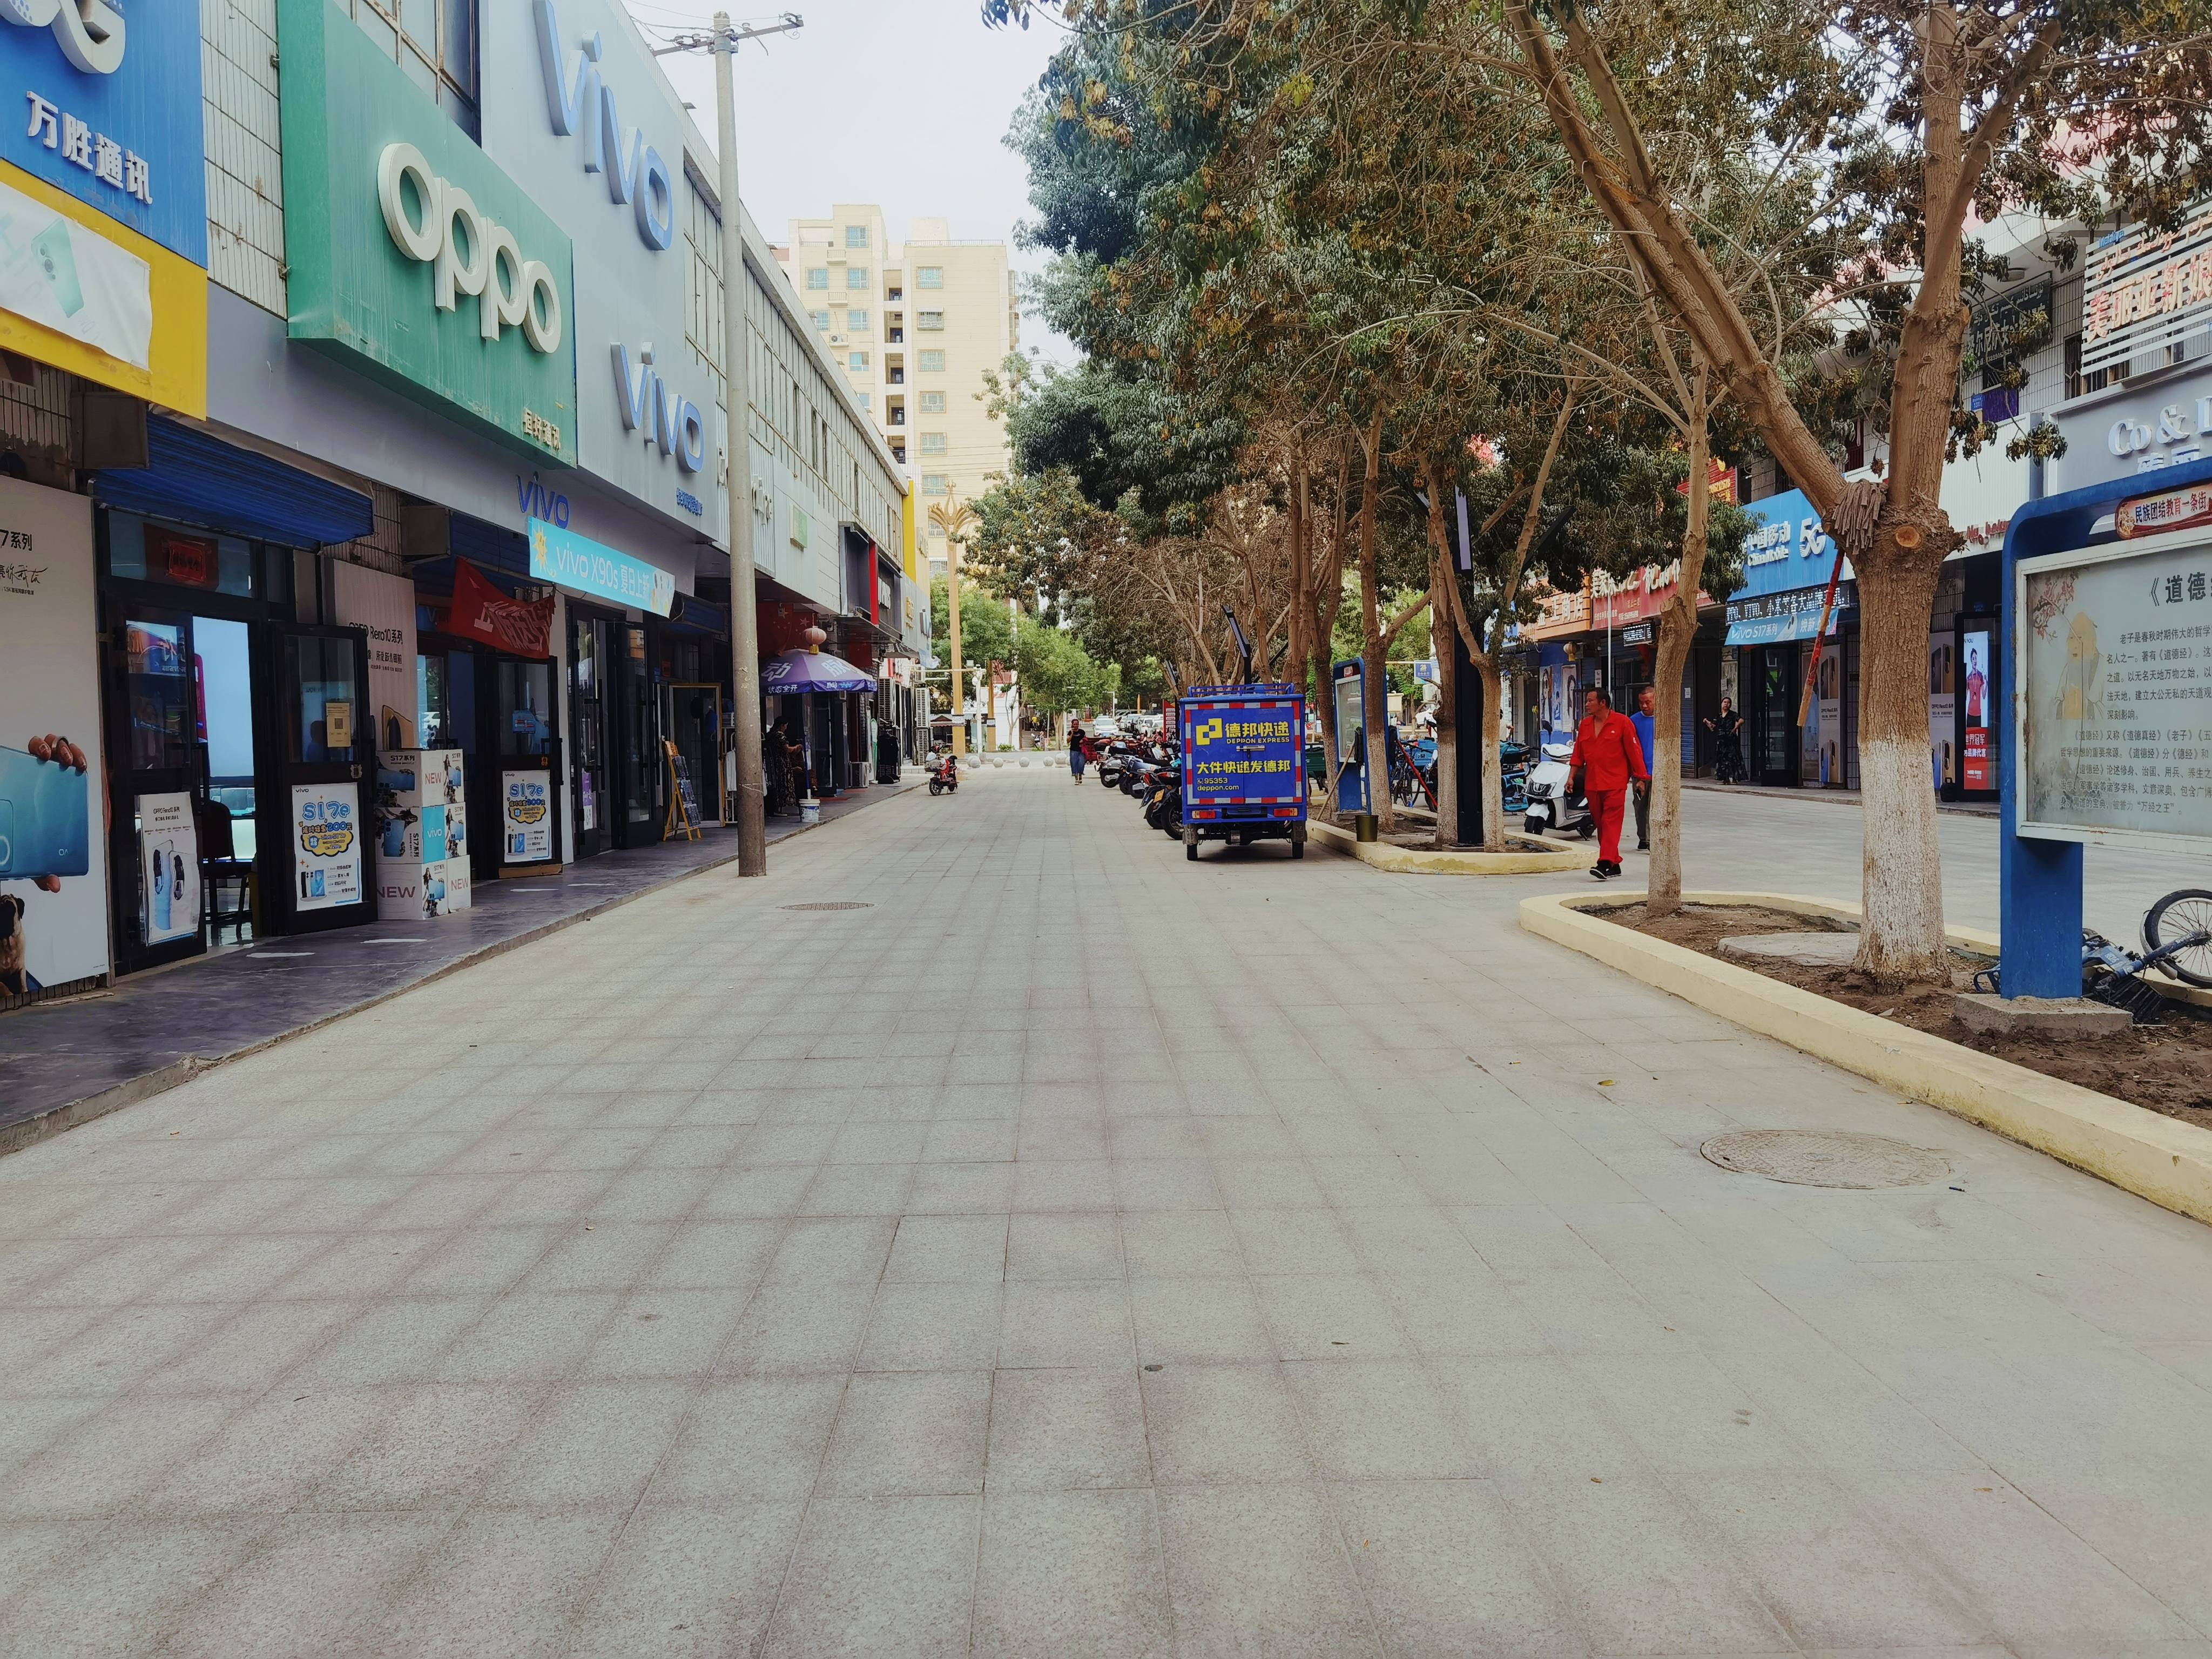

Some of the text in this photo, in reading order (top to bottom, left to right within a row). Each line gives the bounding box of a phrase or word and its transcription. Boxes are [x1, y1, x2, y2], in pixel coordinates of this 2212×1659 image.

[534, 0, 673, 251] vivo
[26, 91, 153, 205] 万胜通讯
[377, 143, 562, 353] oppo
[2087, 252, 2212, 344] 美丽亚新娘
[611, 342, 704, 473] vivo
[2108, 419, 2152, 455] Co
[516, 471, 570, 529] vivo
[2135, 491, 2207, 523] 民族团结教育一条街
[1746, 521, 1791, 551] 中国移动
[1799, 517, 1826, 558] 5G
[556, 542, 650, 601] vivo X90s 夏日上新
[2150, 571, 2212, 606] 《道德
[1731, 626, 1752, 639] vivo
[1753, 622, 1778, 637] S17系列
[761, 663, 793, 682] 动
[768, 684, 798, 693] 状态全开
[1225, 721, 1289, 738] 德邦快递
[2107, 709, 2138, 720] 深刻影响。
[425, 772, 442, 785] NEW
[1196, 759, 1291, 774] 大件快递发德邦
[302, 801, 350, 821] S17e
[428, 827, 442, 838] vivo
[379, 886, 416, 898] NEW
[451, 877, 469, 891] NEW
